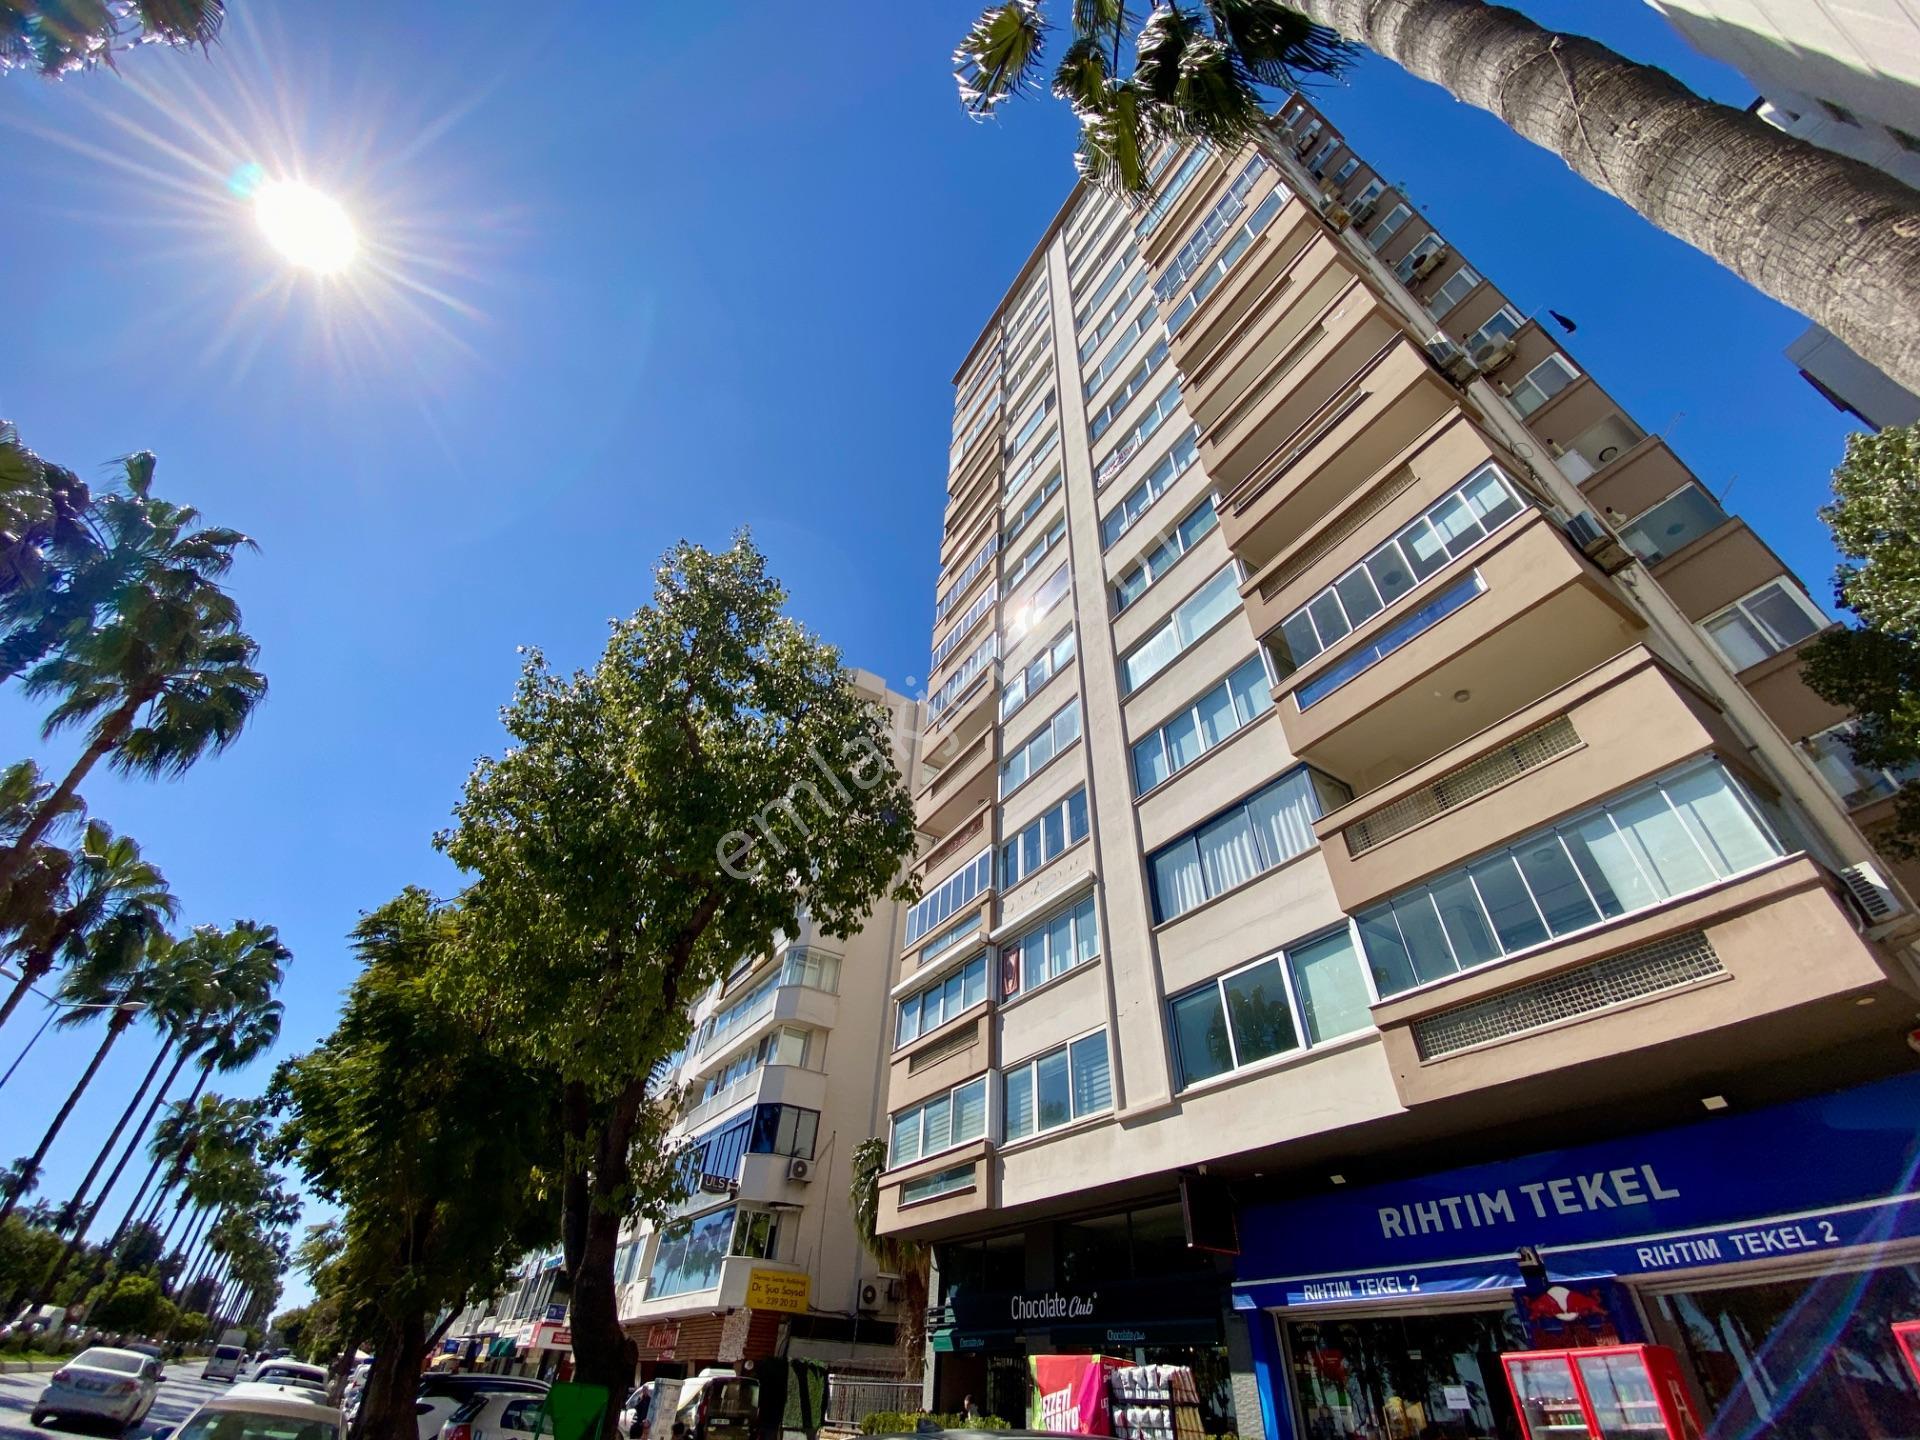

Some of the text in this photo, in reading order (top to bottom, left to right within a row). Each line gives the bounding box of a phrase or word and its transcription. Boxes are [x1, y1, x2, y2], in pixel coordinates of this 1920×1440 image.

[1378, 1164, 1680, 1239] RIHTIM TEKEL
[1636, 1221, 1839, 1268] RIHTIM TEKEL 2
[1303, 1275, 1420, 1301] RIHTIM TEKEL 2
[1011, 1291, 1094, 1320] Chocolate Club
[1107, 1329, 1134, 1341] Chocolate
